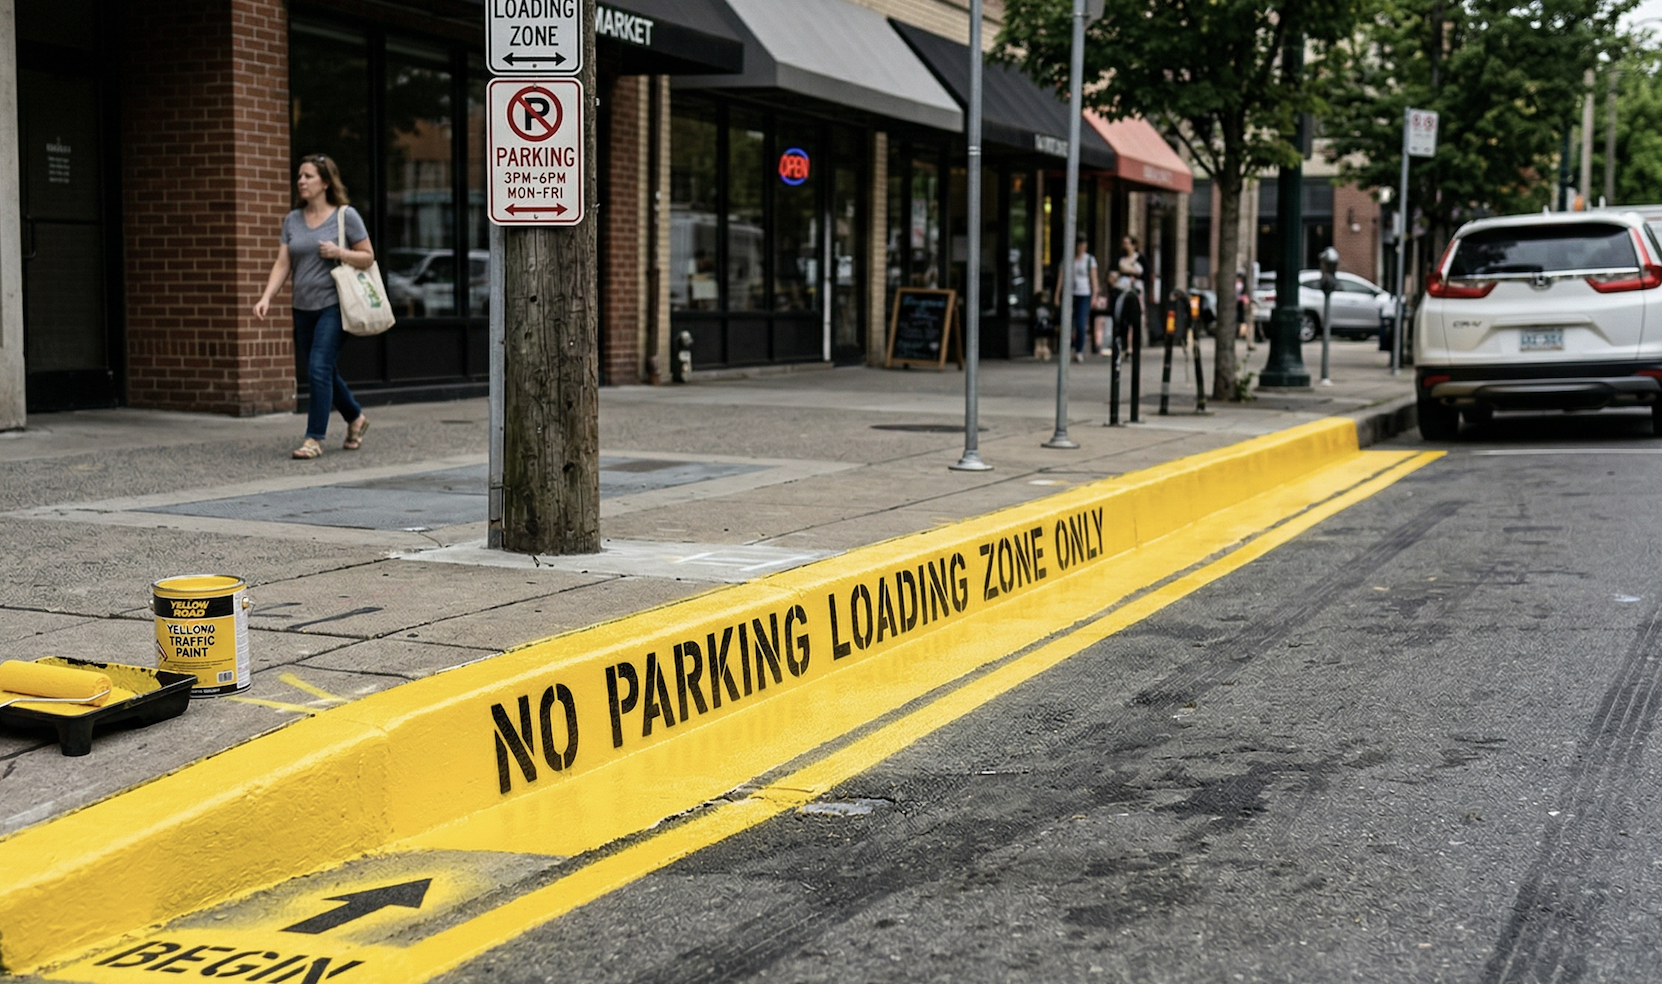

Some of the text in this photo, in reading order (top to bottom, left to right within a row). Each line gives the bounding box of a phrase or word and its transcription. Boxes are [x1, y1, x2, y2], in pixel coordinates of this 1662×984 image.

[494, 0, 575, 18] LOADING
[510, 25, 559, 46] ZONE
[496, 147, 575, 167] PARKING
[779, 154, 810, 178] OPEN
[504, 172, 566, 184] 3PM-6PM
[507, 187, 563, 199] MON-FRI
[170, 600, 210, 610] YELLOW
[173, 609, 206, 618] ROAD
[169, 635, 216, 647] TRAFFIC
[176, 647, 209, 658] PAINT
[490, 507, 1105, 795] NO PARKING LOADING ZONE ONLY
[92, 941, 366, 984] BEGIN
